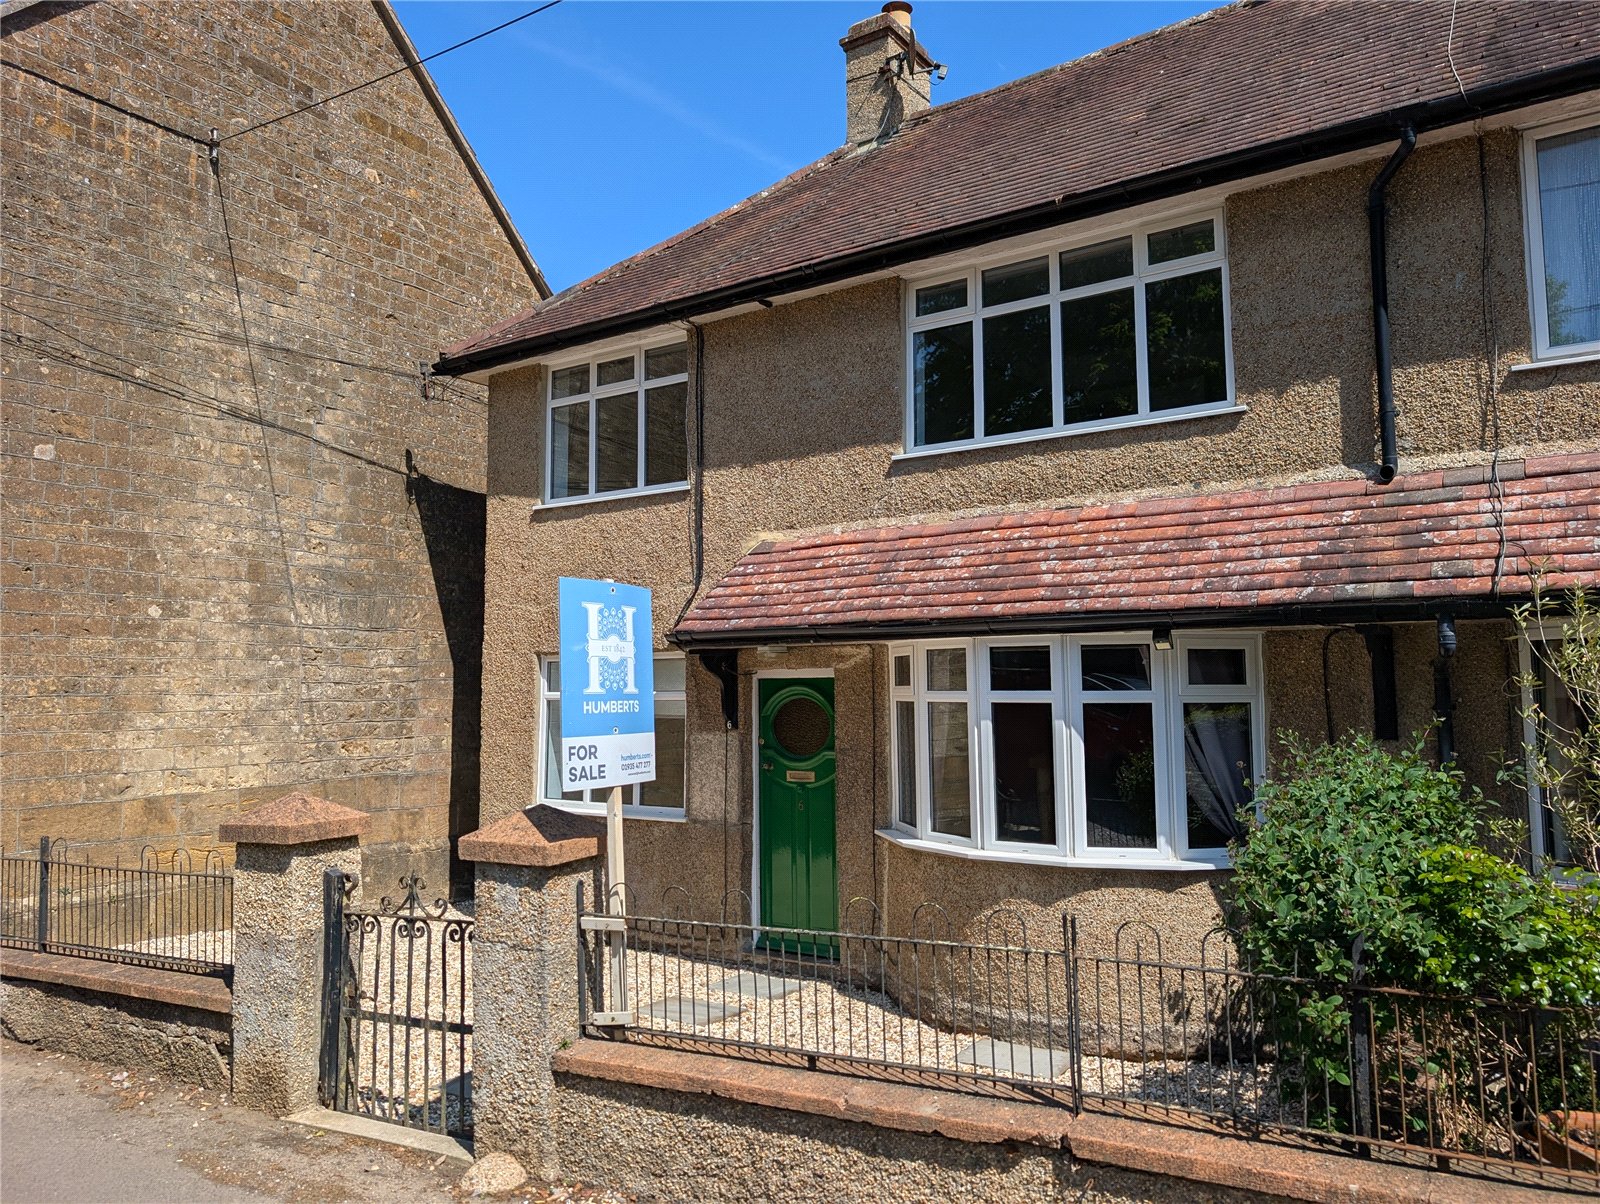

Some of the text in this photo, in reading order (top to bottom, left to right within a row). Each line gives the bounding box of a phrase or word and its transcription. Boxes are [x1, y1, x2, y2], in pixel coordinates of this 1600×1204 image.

[582, 601, 639, 694] H
[601, 644, 612, 652] EST
[583, 700, 640, 714] HUMBERTS
[727, 720, 732, 729] 6
[568, 744, 598, 761] FOR
[621, 753, 651, 761] humberts.com
[621, 763, 635, 771] 01935
[568, 764, 606, 782] SALE
[799, 800, 804, 811] 6
